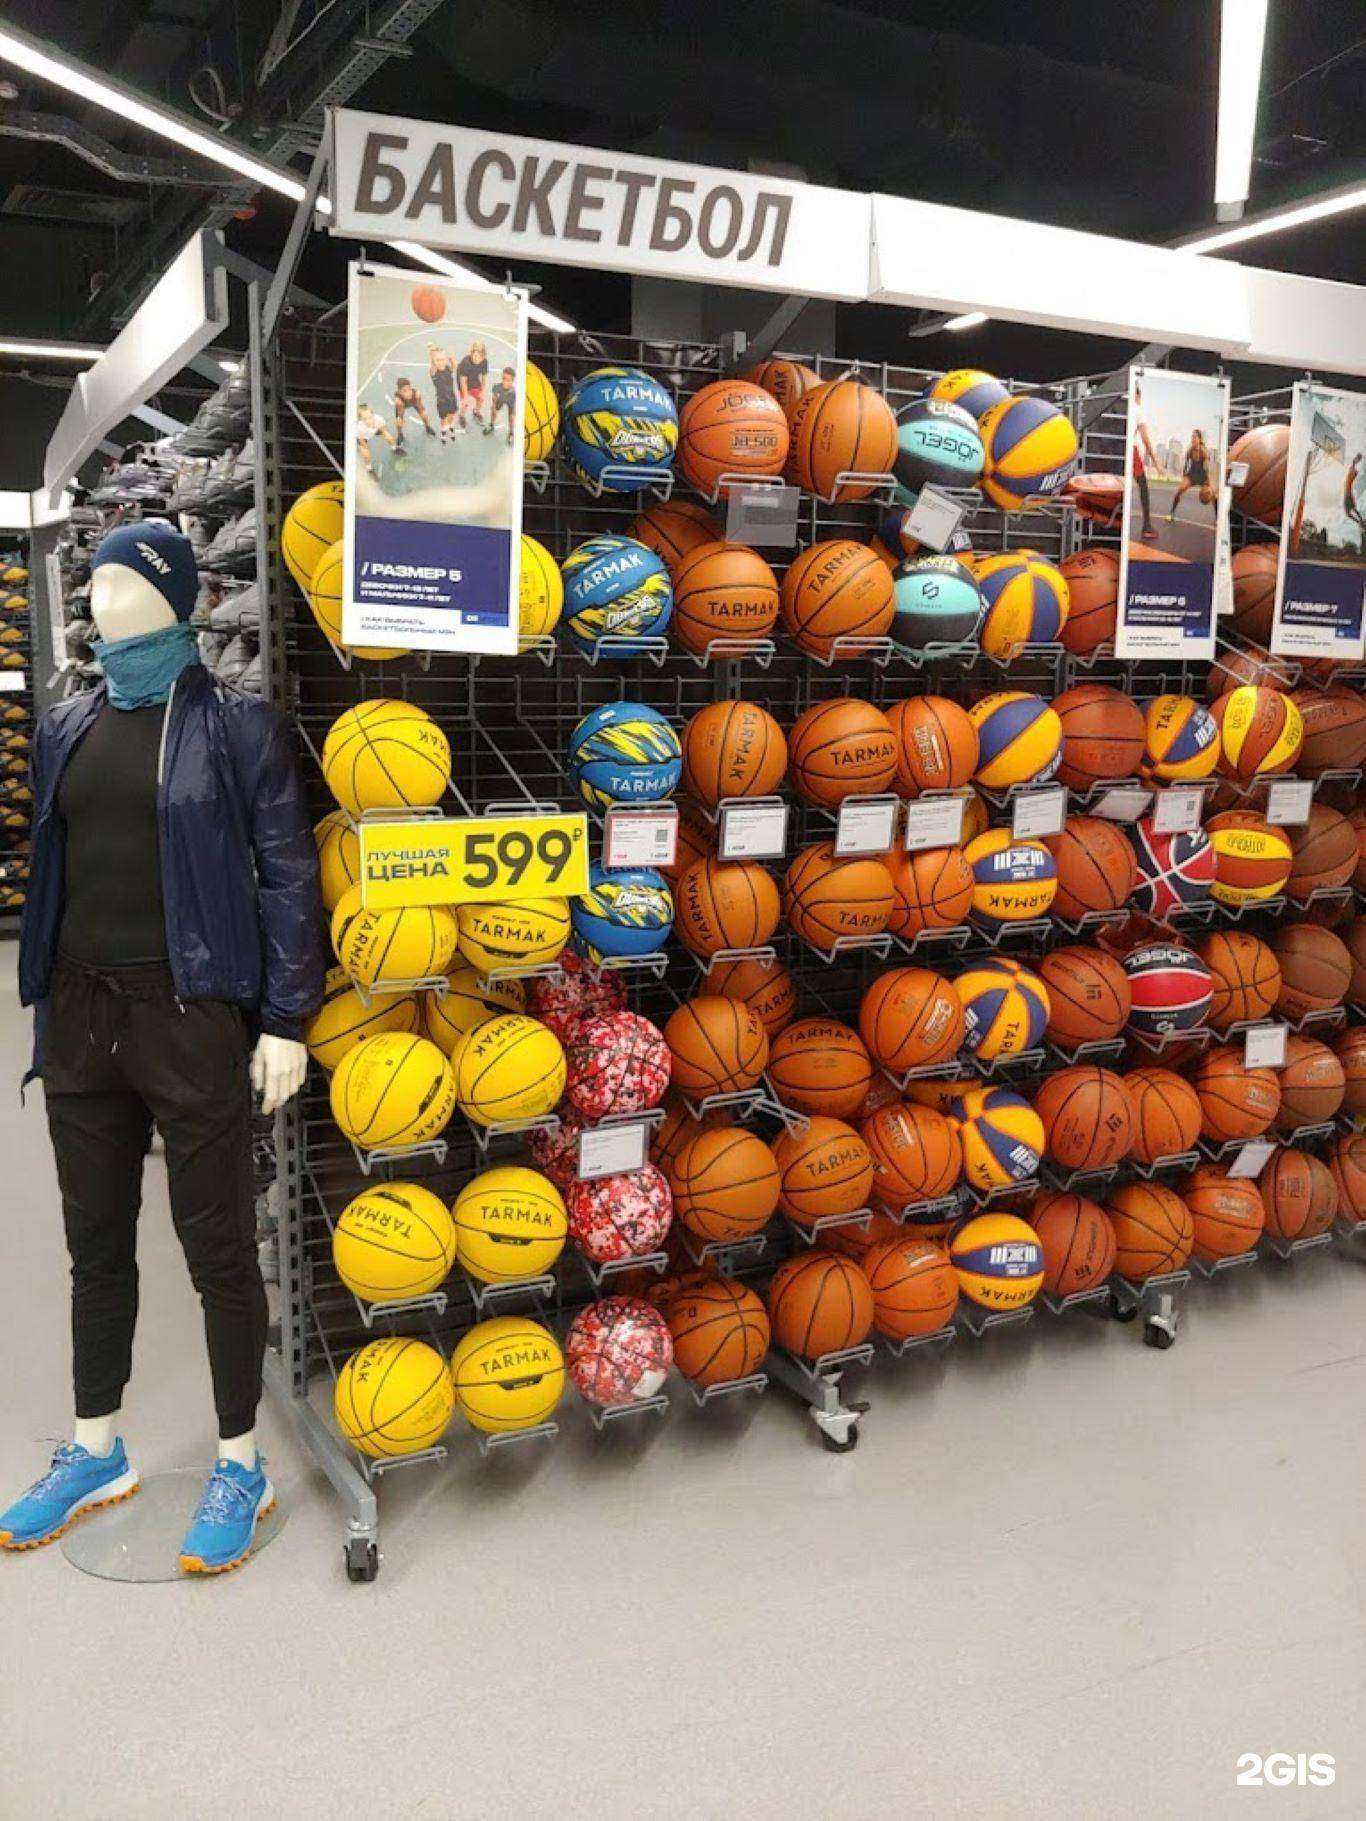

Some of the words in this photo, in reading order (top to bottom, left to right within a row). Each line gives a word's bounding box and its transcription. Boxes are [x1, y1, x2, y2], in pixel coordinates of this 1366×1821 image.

[353, 131, 794, 267] БАСКЕТБОЛ
[371, 563, 447, 581] РАЗМЕР
[573, 552, 644, 599] TARMAK
[367, 847, 451, 862] ЛУЧШАЯ
[367, 860, 450, 882] ЦЕНА
[472, 918, 546, 944] TARMAK
[480, 1204, 553, 1228] TARMAK
[480, 1348, 552, 1376] TARMAK
